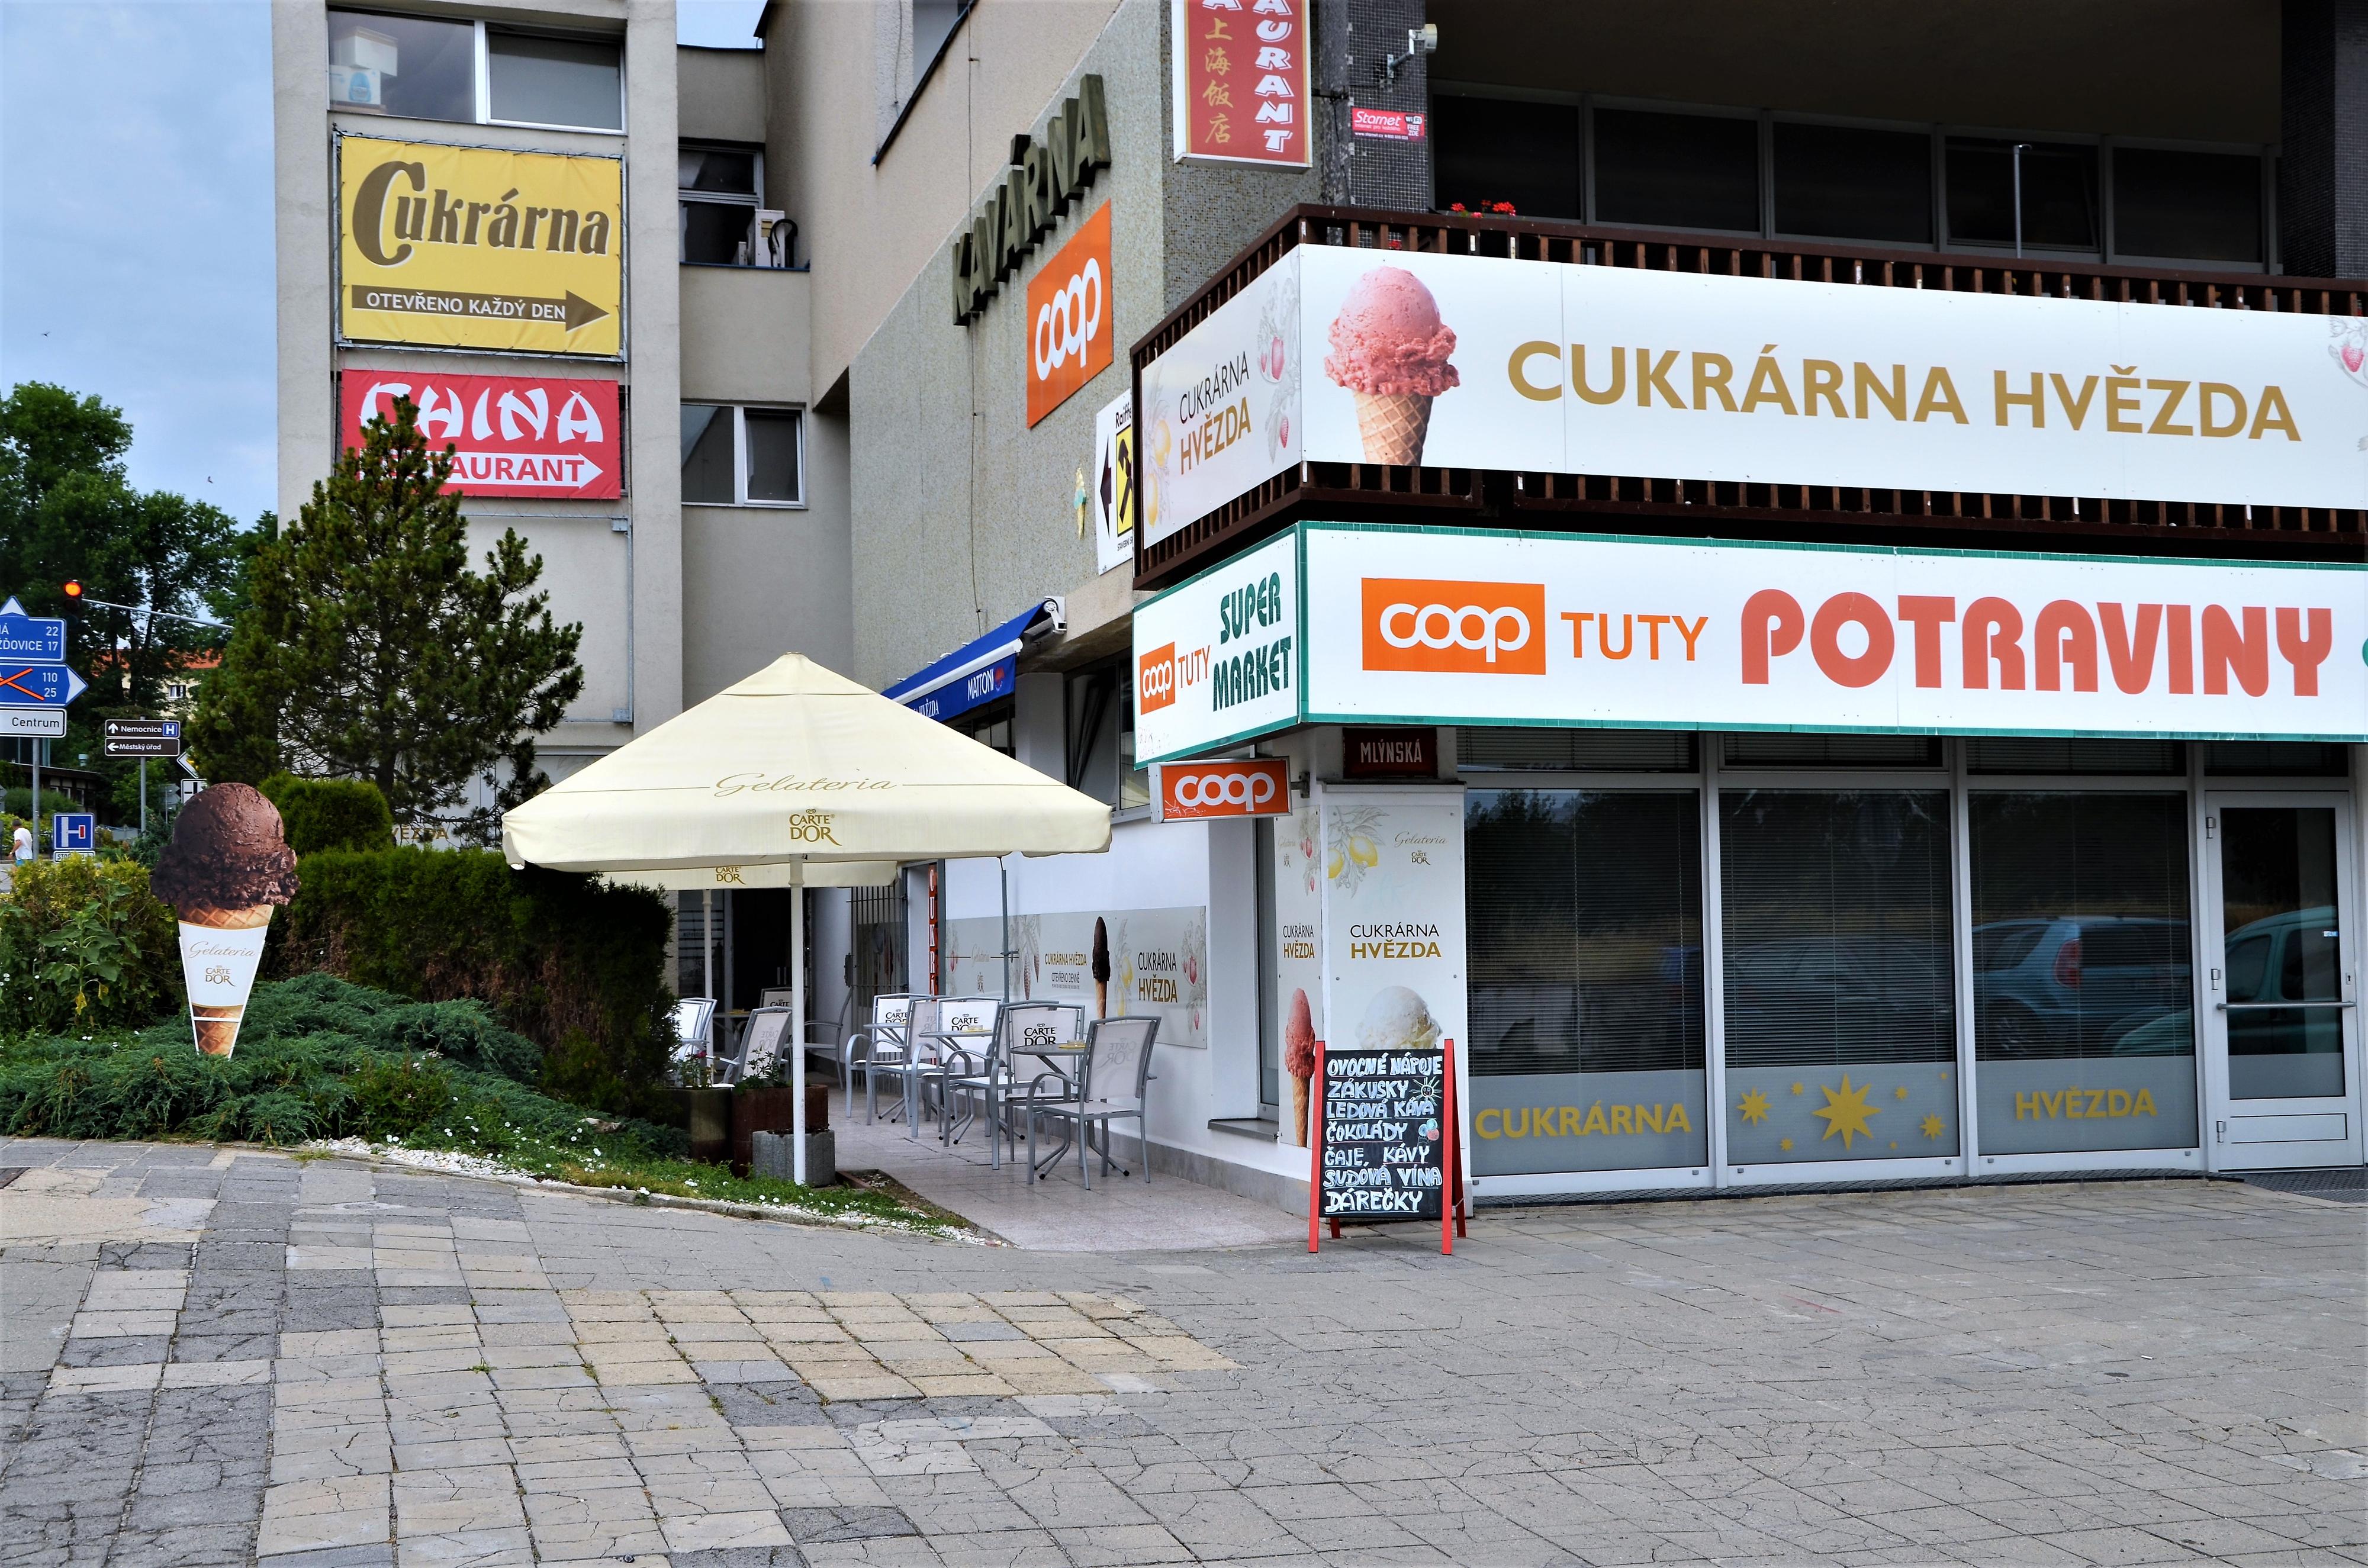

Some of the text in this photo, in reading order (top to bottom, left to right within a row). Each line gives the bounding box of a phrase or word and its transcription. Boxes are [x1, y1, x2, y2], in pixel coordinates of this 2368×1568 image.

[1202, 17, 1234, 144] 上海饭店
[953, 74, 1111, 326] KAVÁRNA
[352, 160, 610, 266] Cukrárna
[366, 289, 565, 320] OTEVŘENO KAŽDÝ DEN
[1035, 258, 1102, 381] coop
[1180, 351, 1249, 424] CUKRÁRNA
[1508, 341, 2301, 441] CUKRÁRNA HVĚZDA
[358, 382, 603, 443] CHINA
[1180, 397, 1251, 475] HVĚZDA
[1220, 572, 1281, 645] SUPER
[46, 626, 58, 636] 22
[1379, 588, 2332, 697] coop TUTY POTRAVINY
[48, 641, 58, 651] 17
[43, 672, 57, 682] 110
[968, 668, 994, 701] MATTONI
[1143, 645, 1211, 700] coop TUTY
[1213, 636, 1291, 712] MARKET
[44, 688, 57, 697] 25
[12, 717, 59, 727] Centrum
[1360, 739, 1422, 763] MLÝNSKÁ
[714, 772, 897, 797] Gelateria
[1175, 772, 1275, 812] coop
[789, 814, 831, 826] CARTE
[1394, 831, 1448, 848] Gelateria
[1283, 923, 1314, 938] CUKRÁRNA
[1350, 922, 1439, 938] CUKRÁRNA
[189, 941, 256, 958] Gelateria
[1045, 951, 1068, 965] CUKRÁRNA
[1138, 948, 1177, 971] CUKRÁRNA
[1283, 940, 1315, 958] HVĚZDA
[1351, 939, 1442, 958] HVĚZDA
[1138, 974, 1177, 1003] HVĚZDA
[1024, 1027, 1056, 1037] CARTE
[1327, 1052, 1443, 1076] OVOCNÉ NÁPOJE
[1327, 1078, 1409, 1099] ZÁKUSKY
[1326, 1097, 1434, 1118] LEDOVÁ KÁVA
[2016, 1086, 2157, 1120] HVĚZDA
[1326, 1120, 1408, 1141] ČOKOLÁDY
[1475, 1100, 1691, 1139] CUKRÁRNA
[1383, 1143, 1430, 1163] KÁVY
[1323, 1164, 1442, 1187] SUDOVÁ VÍNA
[1325, 1187, 1423, 1212] DÁREČKY
